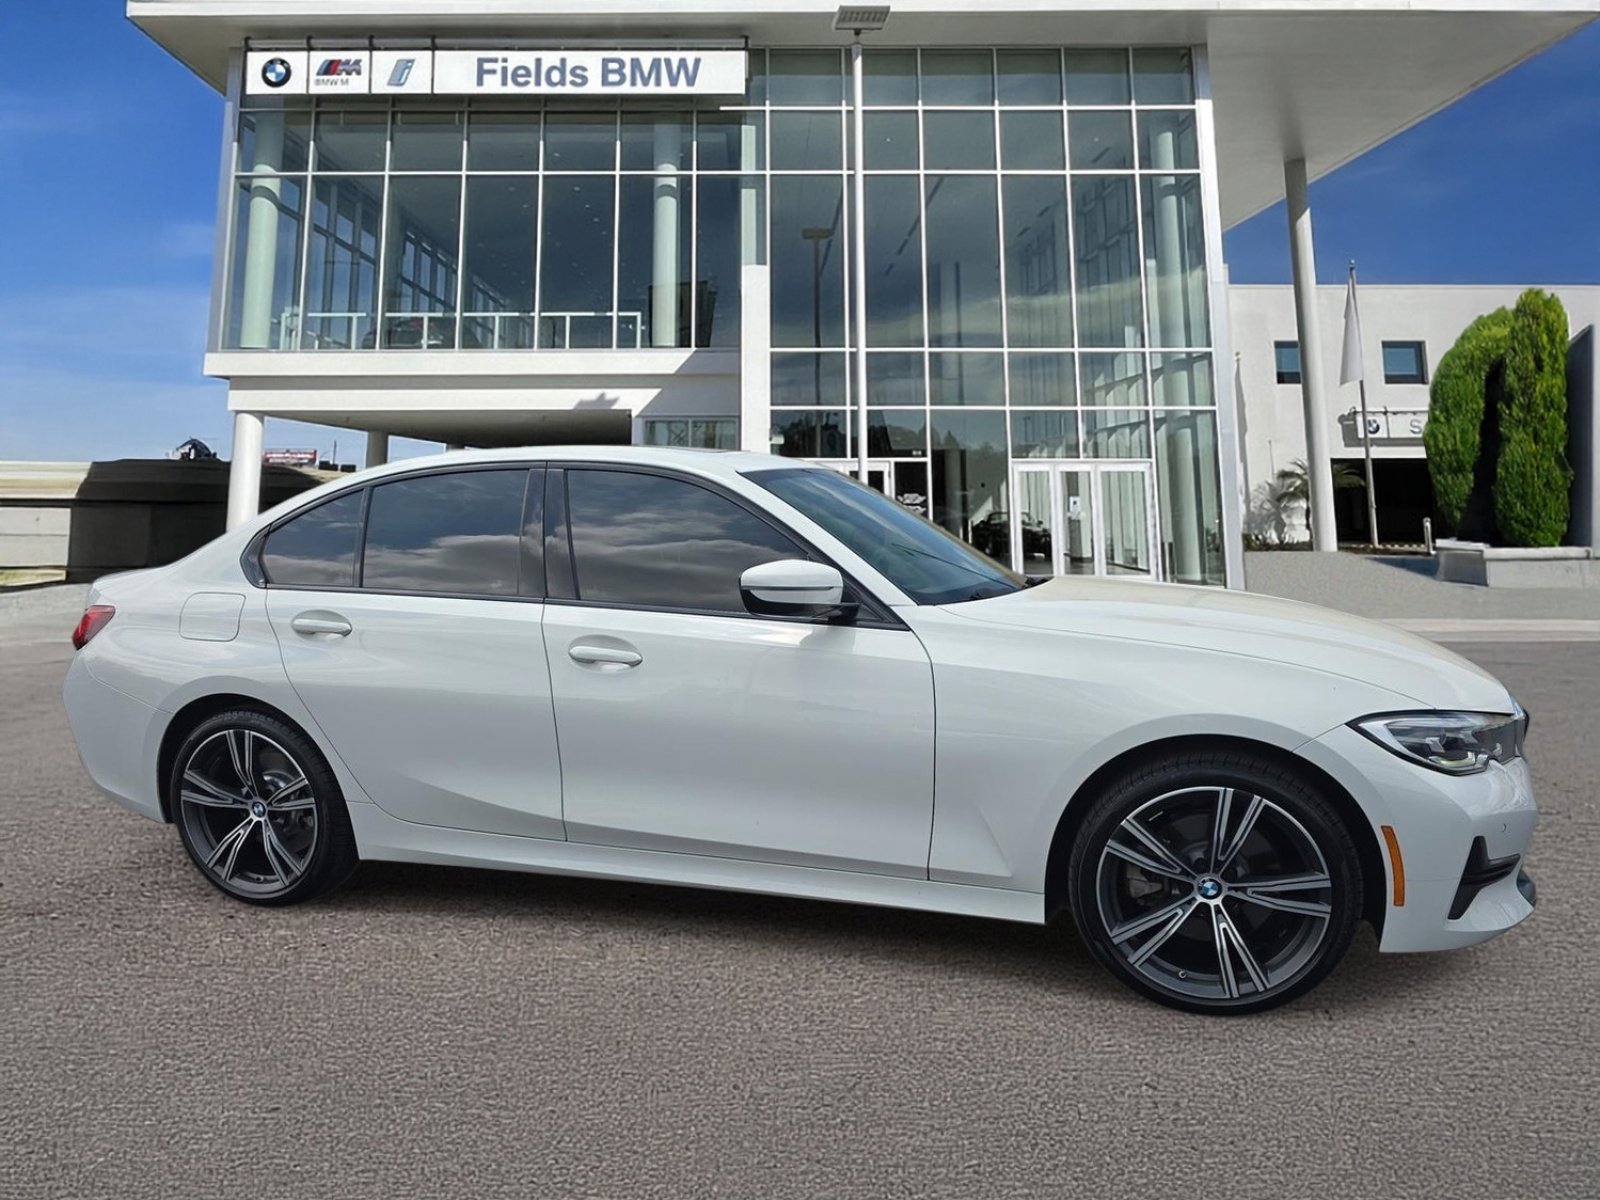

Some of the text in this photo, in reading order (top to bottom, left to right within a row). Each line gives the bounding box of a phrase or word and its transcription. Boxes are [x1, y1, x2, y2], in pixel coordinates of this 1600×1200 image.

[315, 78, 338, 86] BMW
[476, 57, 702, 88] Fields BMW
